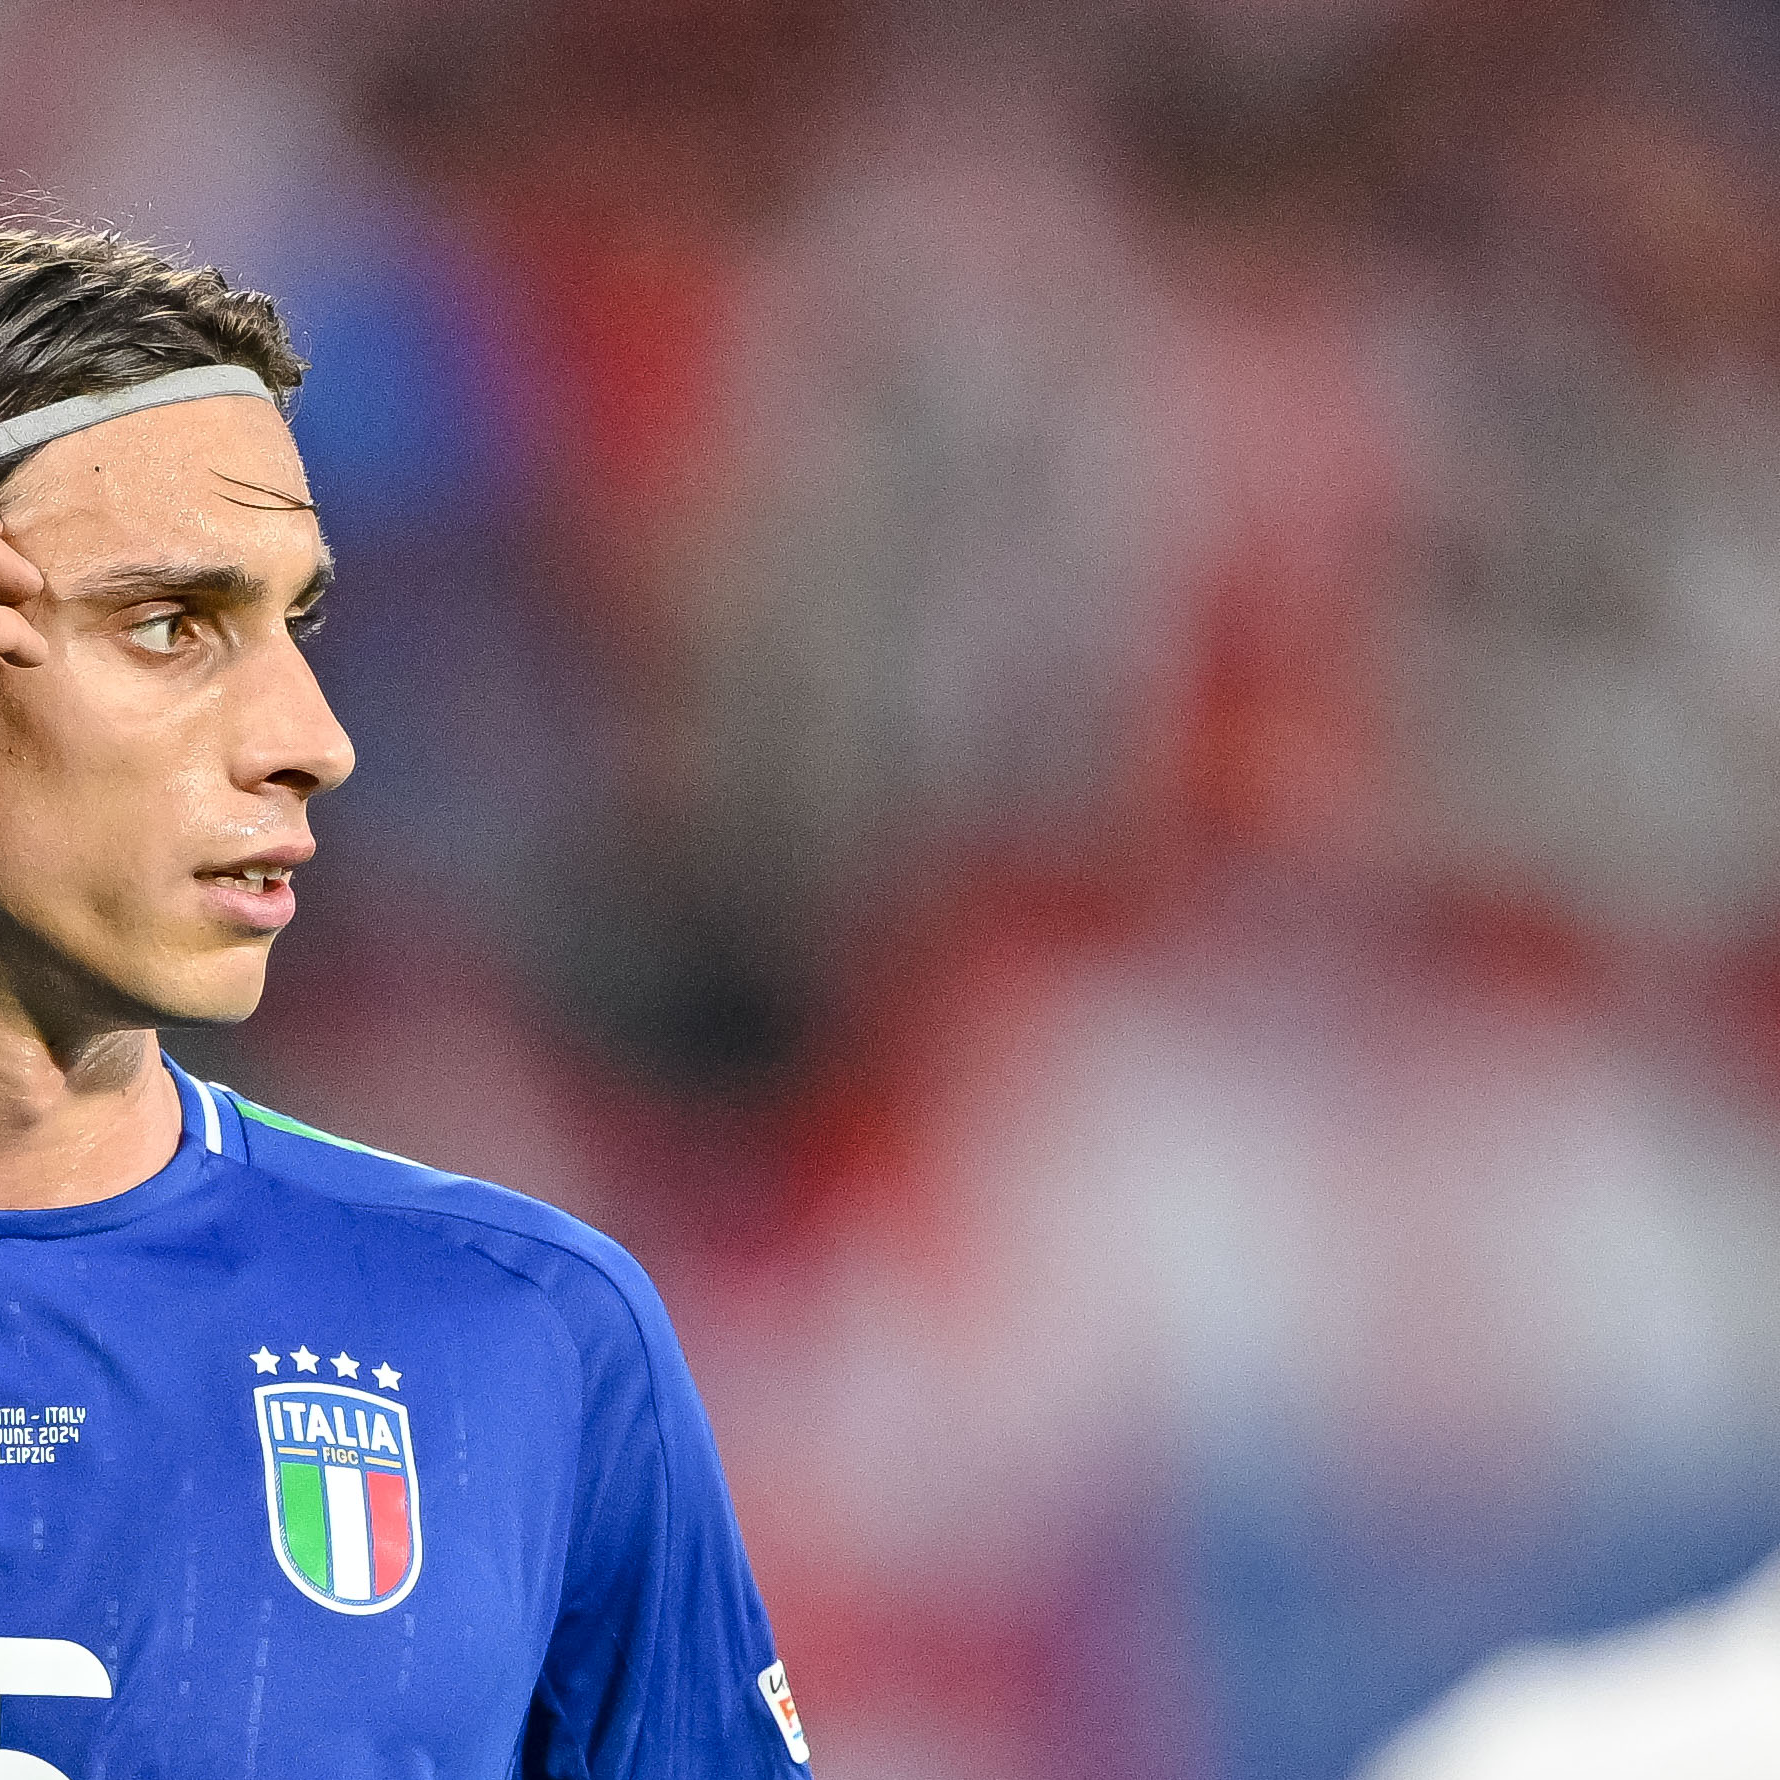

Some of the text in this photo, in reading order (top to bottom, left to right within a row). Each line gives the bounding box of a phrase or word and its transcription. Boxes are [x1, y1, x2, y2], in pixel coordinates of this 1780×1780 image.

[45, 1406, 87, 1425] ITALY
[38, 1426, 80, 1445] 2024
[270, 1400, 401, 1456] ITALIA
[322, 1446, 360, 1465] FIGC
